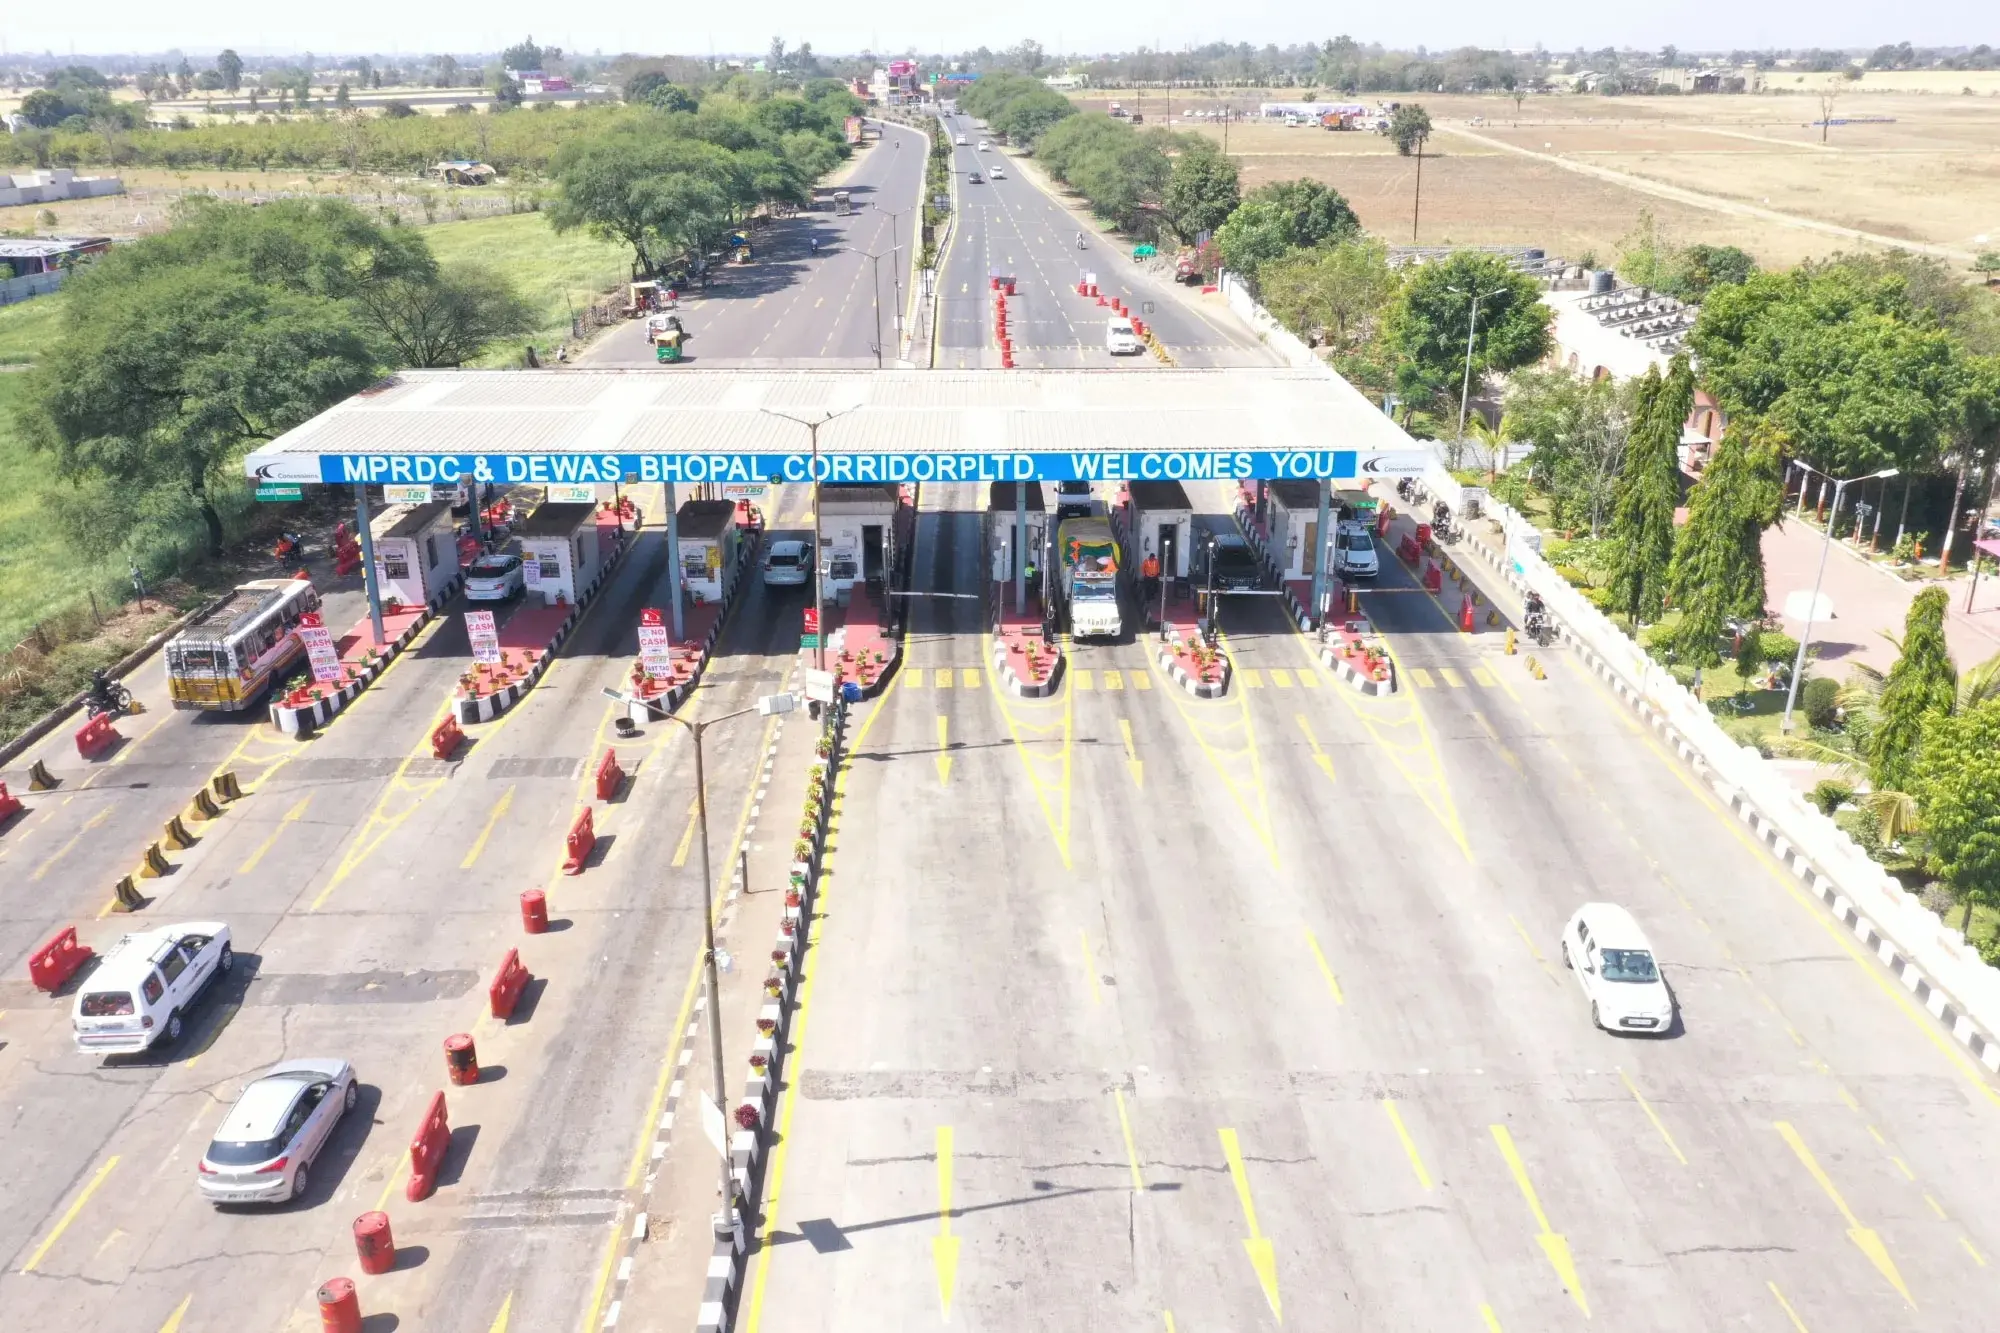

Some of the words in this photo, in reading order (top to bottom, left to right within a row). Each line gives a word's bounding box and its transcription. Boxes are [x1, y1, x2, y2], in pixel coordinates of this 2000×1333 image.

[341, 455, 462, 482] MPRDC
[473, 455, 494, 482] &
[506, 455, 621, 482] DEWAS
[640, 455, 768, 481] BHOPAL
[1071, 453, 1253, 480] WELCOMES
[1273, 453, 1334, 479] YOU
[468, 623, 495, 631] CASH
[306, 640, 332, 648] CASH
[640, 638, 666, 646] CASH
